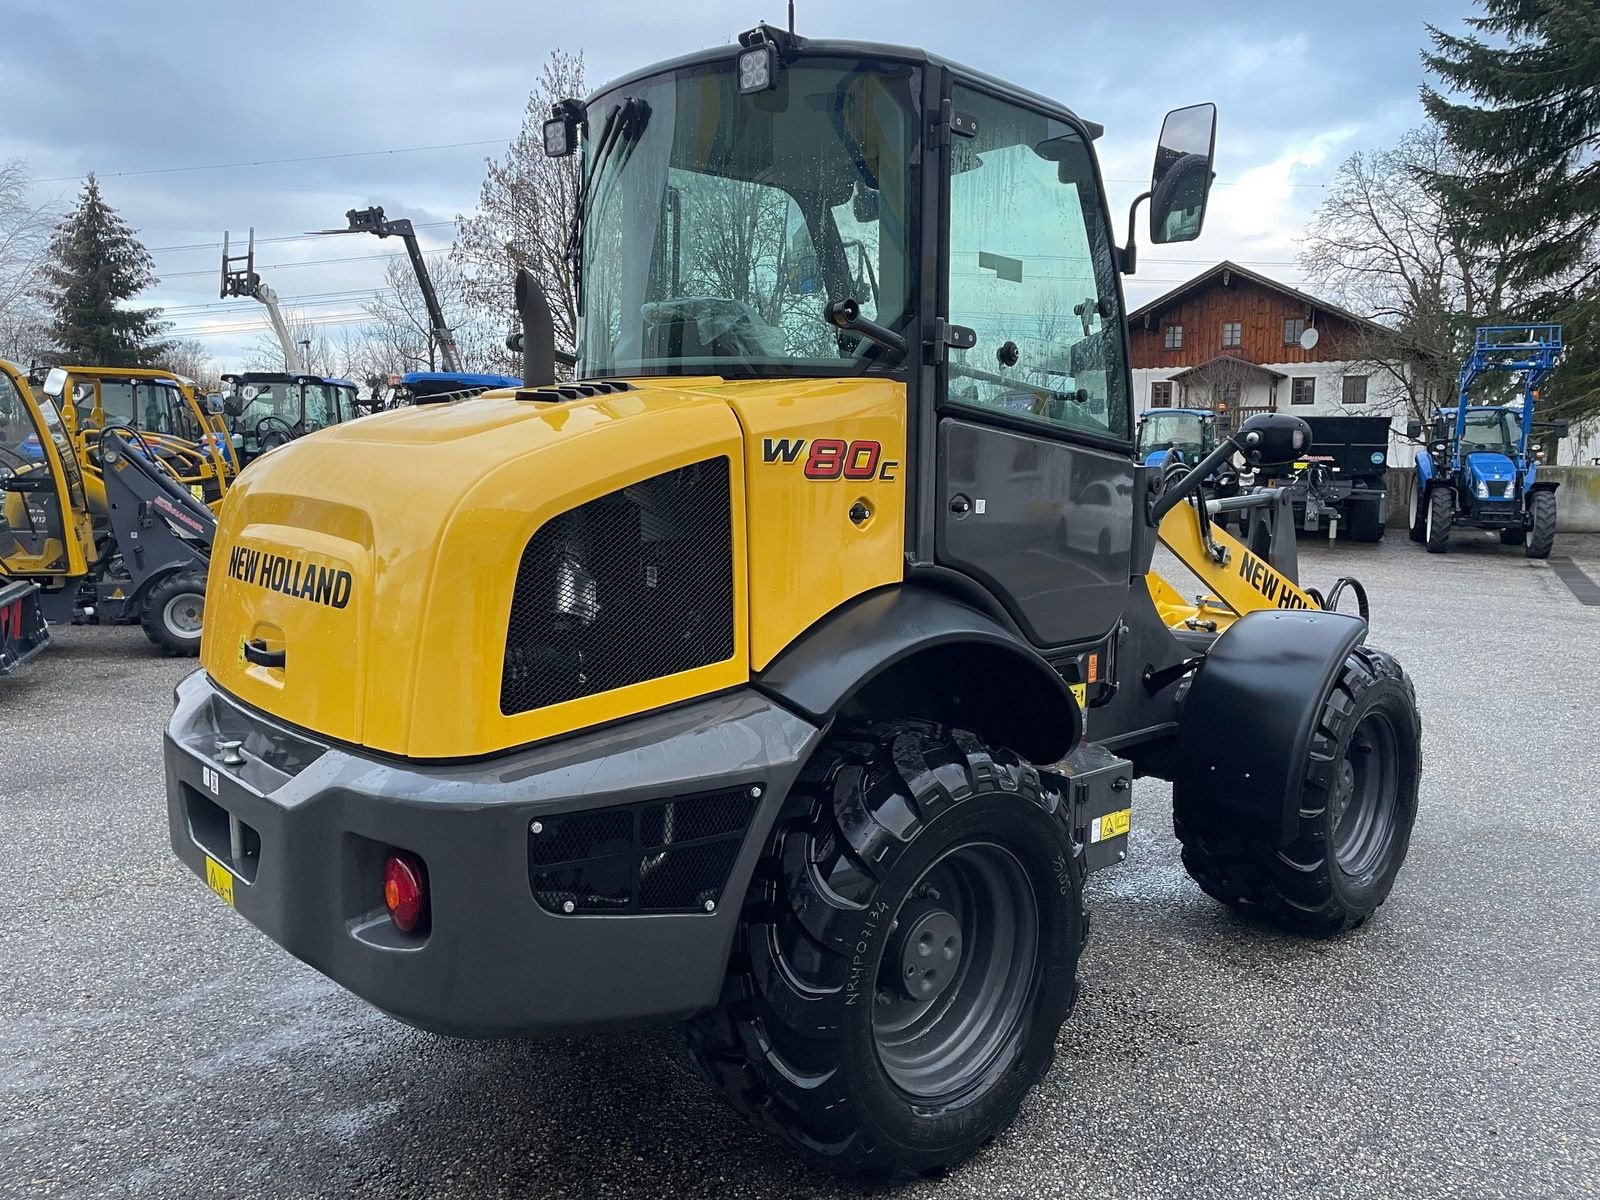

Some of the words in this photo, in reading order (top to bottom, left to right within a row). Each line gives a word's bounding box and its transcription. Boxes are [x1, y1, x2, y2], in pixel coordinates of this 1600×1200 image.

[245, 388, 254, 398] 40
[763, 438, 899, 481] W80C
[228, 545, 261, 584] NEW
[259, 553, 352, 610] HOLLAND
[1239, 551, 1280, 602] NEW
[1277, 583, 1313, 609] HO
